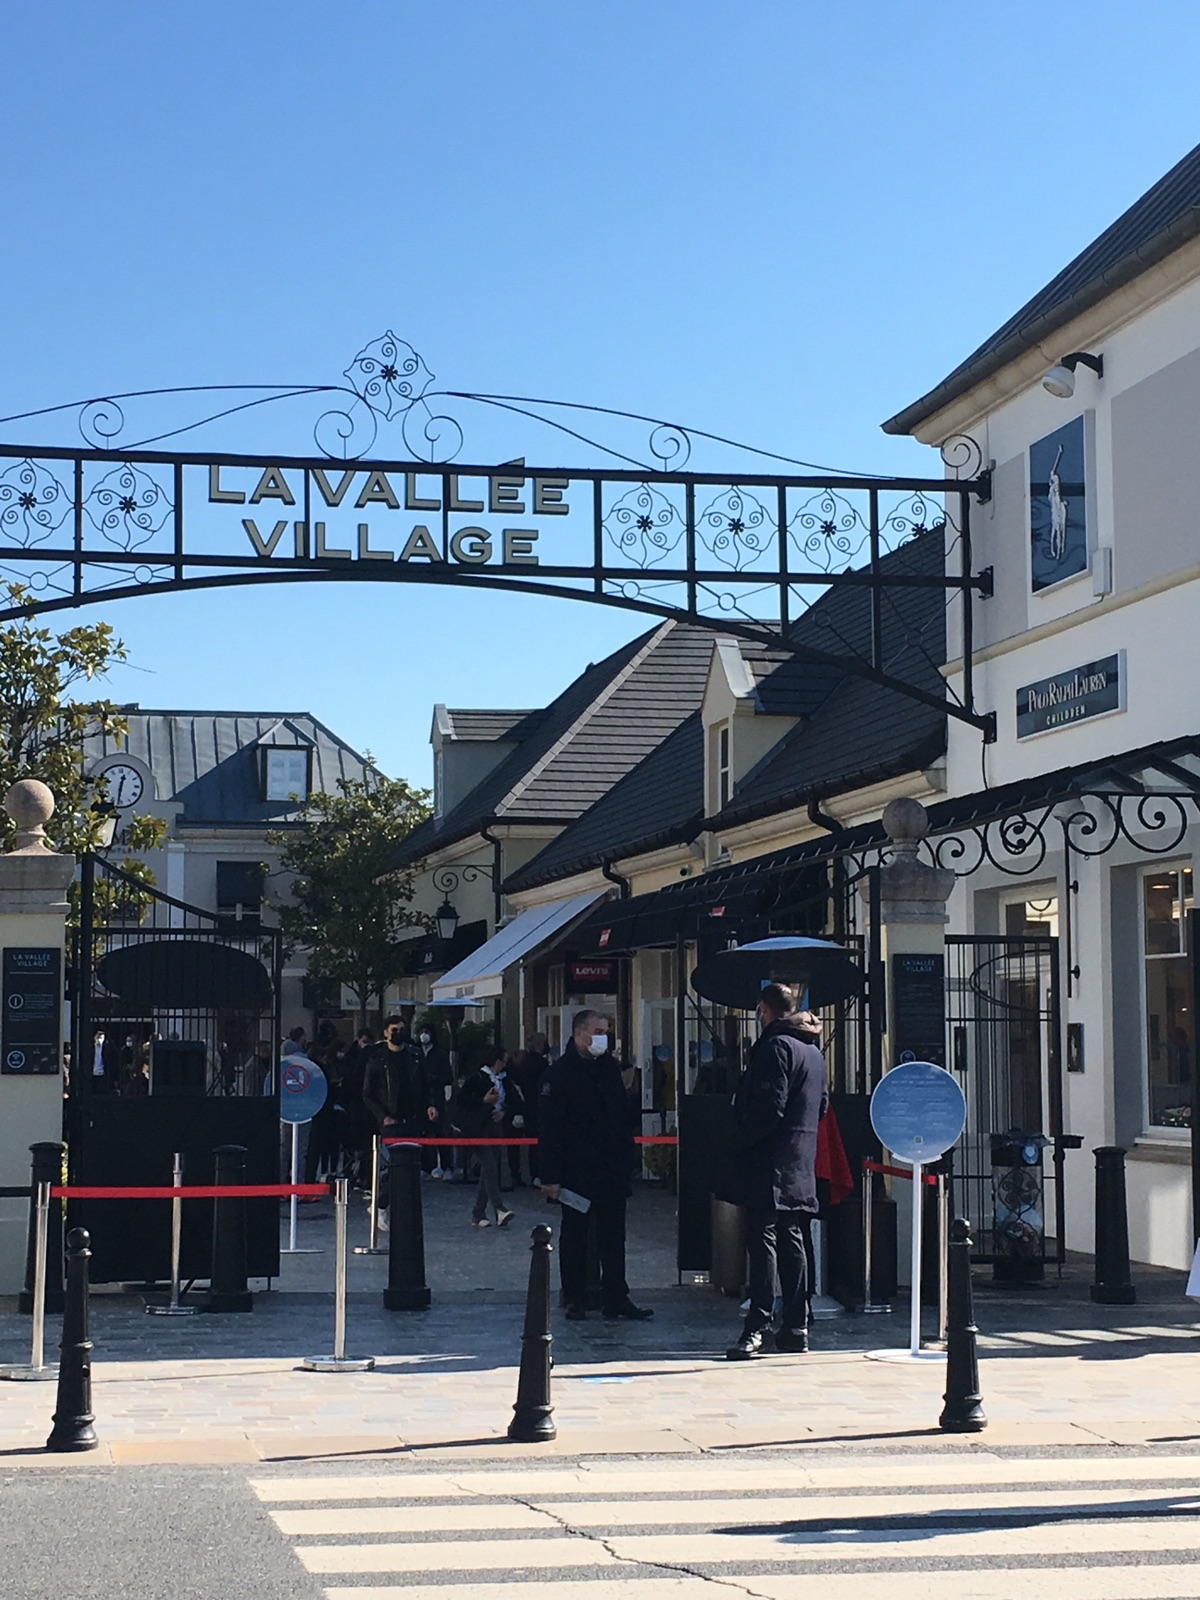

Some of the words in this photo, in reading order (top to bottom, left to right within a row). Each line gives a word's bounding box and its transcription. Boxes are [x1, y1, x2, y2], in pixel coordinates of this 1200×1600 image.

[209, 463, 296, 506] LA
[310, 457, 570, 515] VALLÉE
[242, 519, 539, 565] VILLAGE
[1046, 704, 1086, 726] CHILDREN
